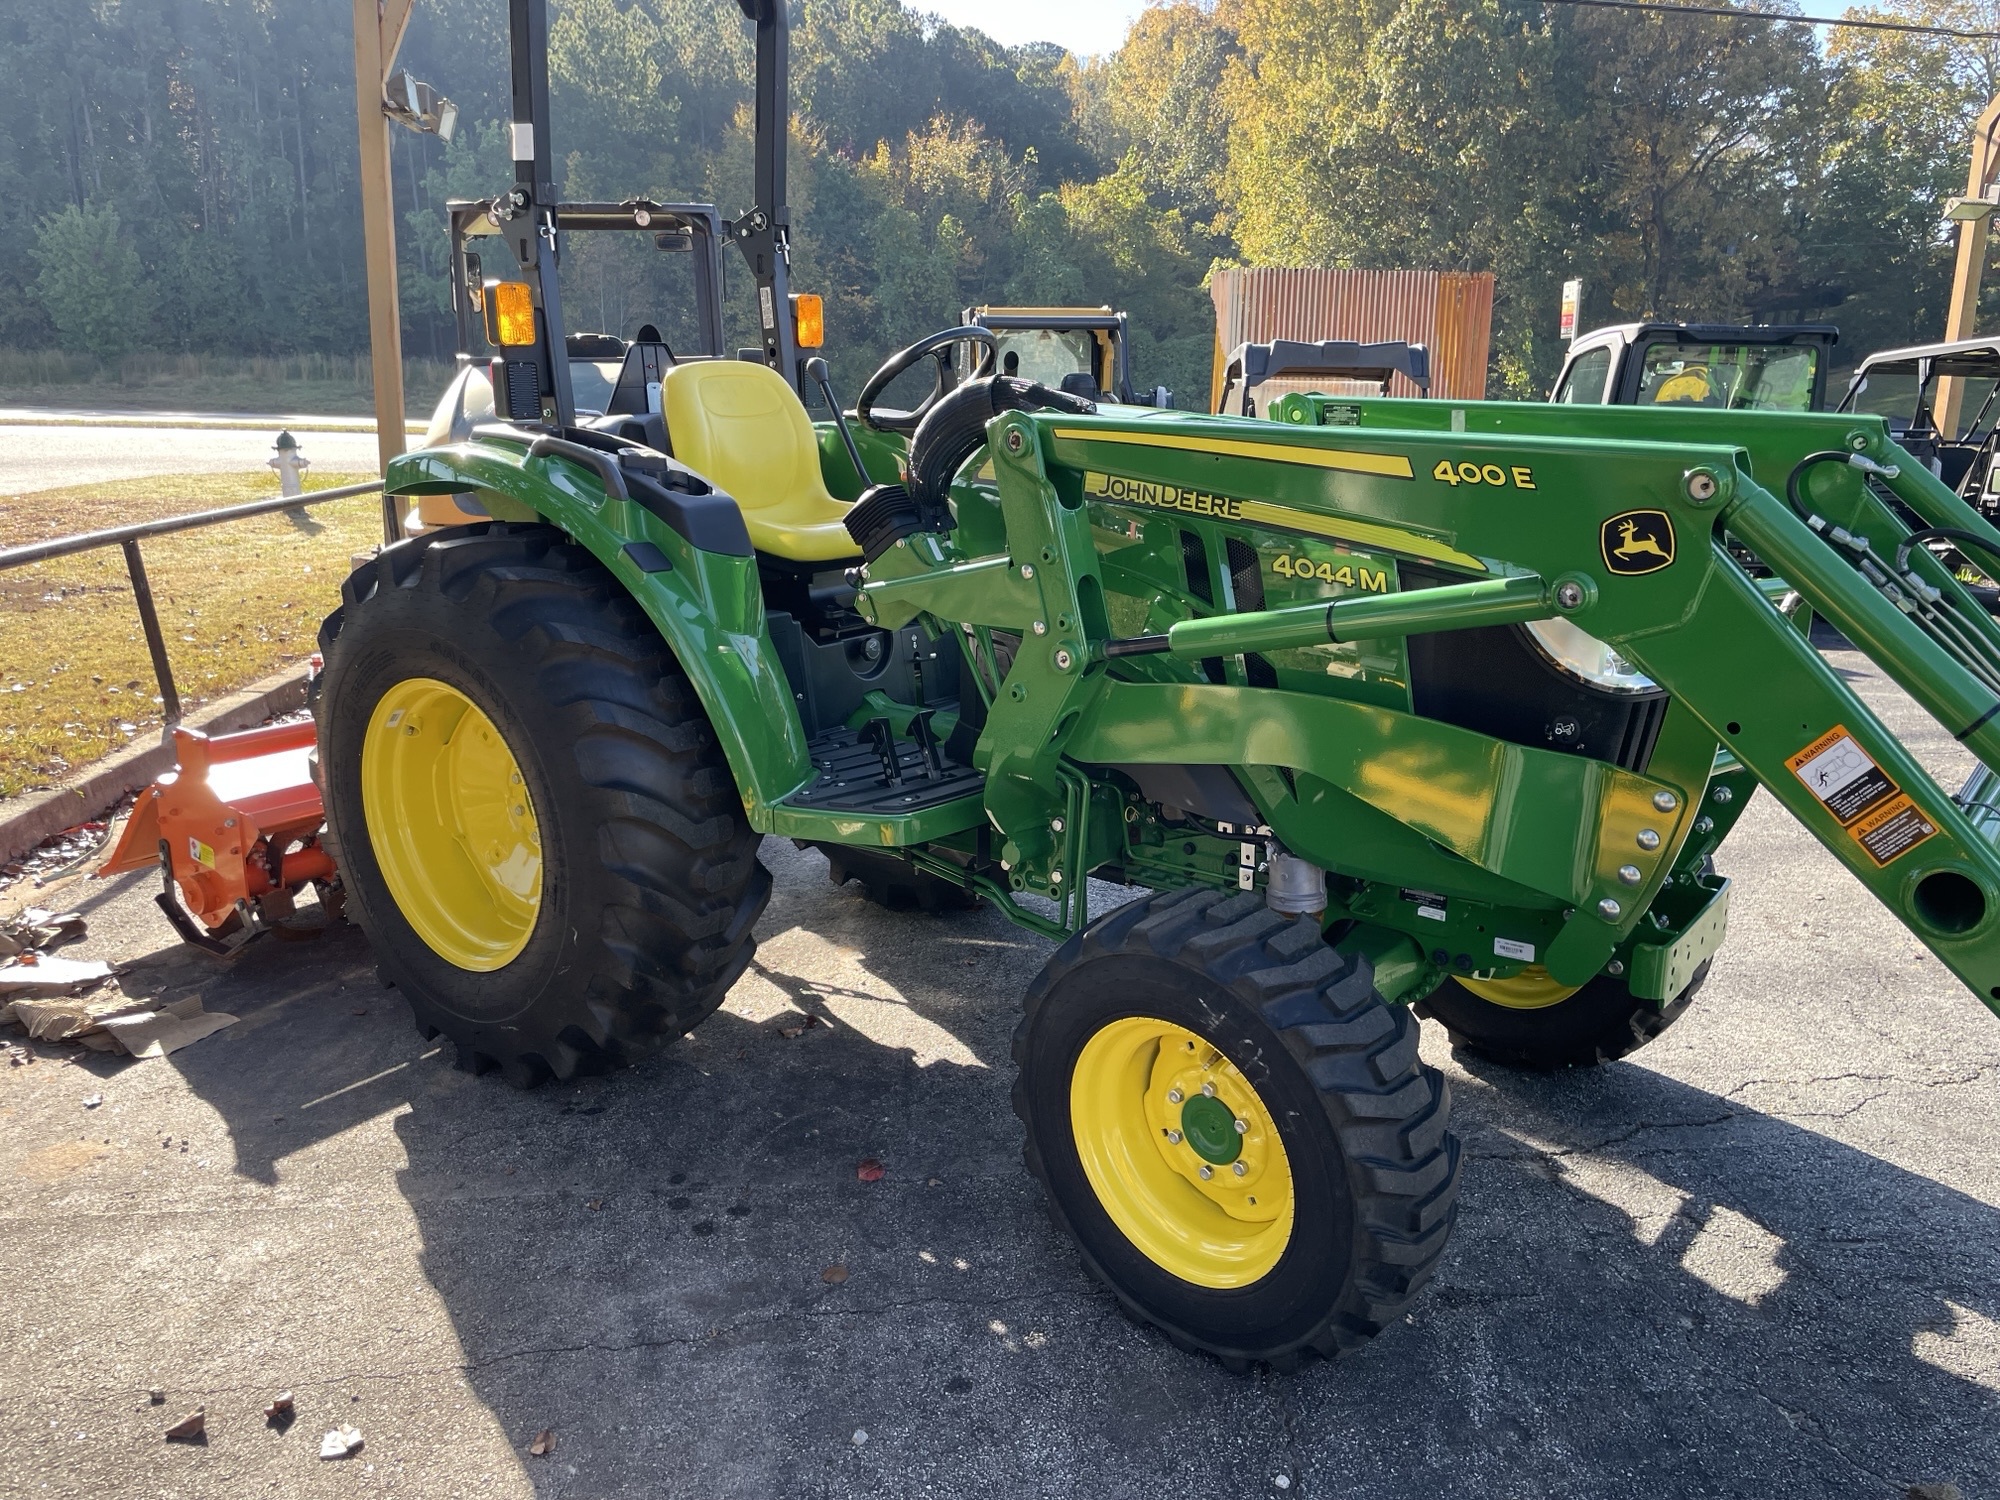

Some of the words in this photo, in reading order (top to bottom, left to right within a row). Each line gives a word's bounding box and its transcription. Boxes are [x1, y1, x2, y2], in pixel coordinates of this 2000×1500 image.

[1433, 460, 1507, 487] 400
[1510, 466, 1537, 489] E
[1098, 475, 1157, 503] JOHN
[1161, 485, 1242, 517] DEERE
[1272, 554, 1356, 587] 4044
[1359, 567, 1387, 593] M
[1802, 732, 1840, 760] WARNING
[1866, 801, 1906, 828] WARNING
